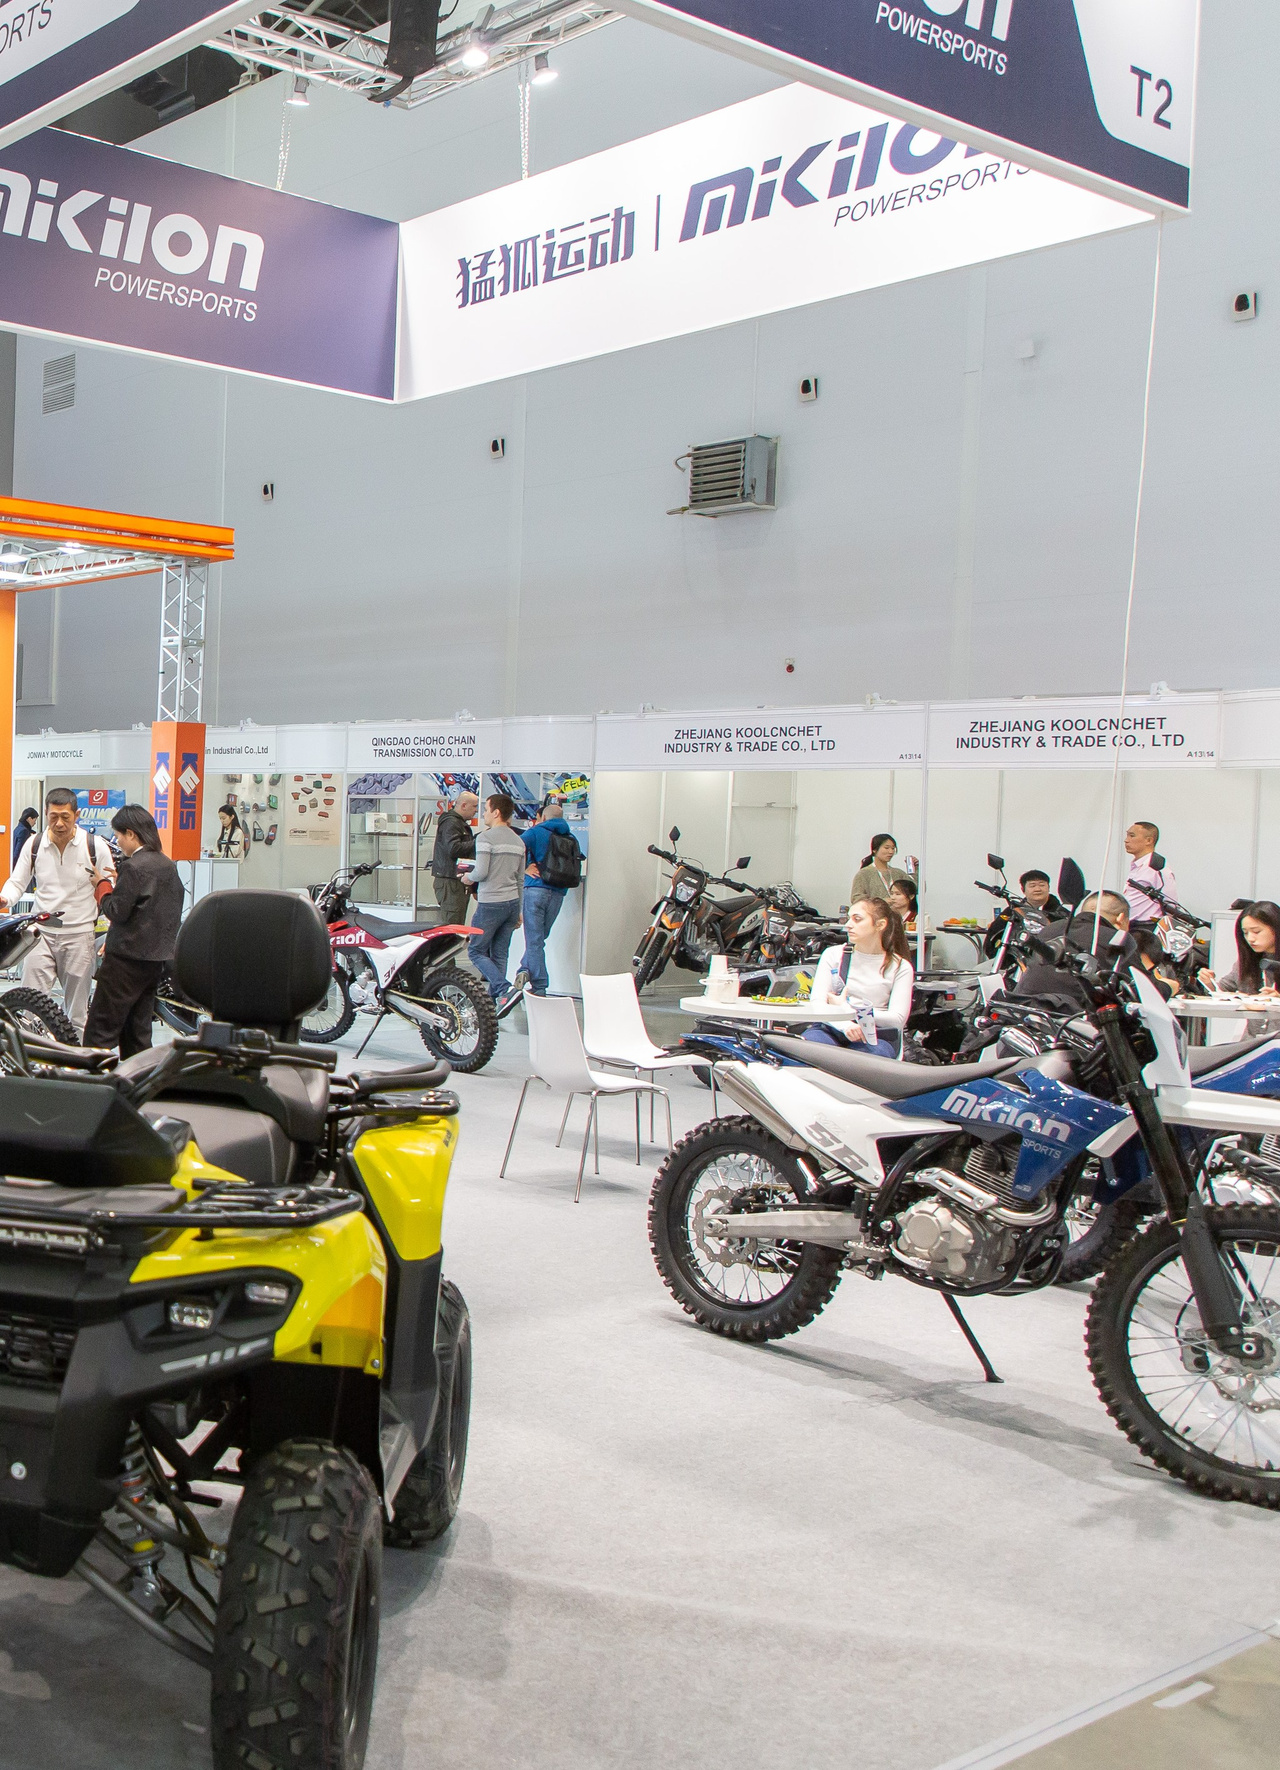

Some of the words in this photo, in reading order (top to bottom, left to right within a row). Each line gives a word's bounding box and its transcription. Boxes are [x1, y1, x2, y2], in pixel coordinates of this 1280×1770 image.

[876, 2, 1008, 76] POWERSPORTS
[1130, 65, 1172, 130] T2
[456, 206, 635, 309] 猛狐运动
[94, 267, 258, 322] POWERSPORTS
[674, 728, 732, 740] ZHEJIANG
[735, 725, 822, 738] KOOLCNCHET
[969, 720, 1045, 733] ZHEJIANG
[1050, 717, 1167, 731] KOOLCNCHET
[371, 737, 411, 747] QINGDAO
[413, 736, 445, 746] CHOHO
[448, 735, 476, 745] CHAIN
[664, 742, 722, 753] INDUSTRY
[724, 741, 733, 753] &
[737, 741, 778, 752] TRADE
[781, 741, 806, 753] CO.,
[811, 740, 836, 751] LTD
[956, 736, 1031, 749] INDUSTRY
[1036, 735, 1047, 748] &
[1052, 735, 1107, 748] TRADE
[1112, 734, 1145, 749] CO.,
[1152, 734, 1185, 747] LTD
[27, 751, 49, 759] JONWAY
[50, 750, 83, 758] MOTOCYCLE
[213, 746, 243, 754] Industrial
[244, 745, 269, 756] Co.,Ltd
[374, 748, 437, 758] TRANSMISSION
[1022, 1138, 1062, 1160] SPORTS
